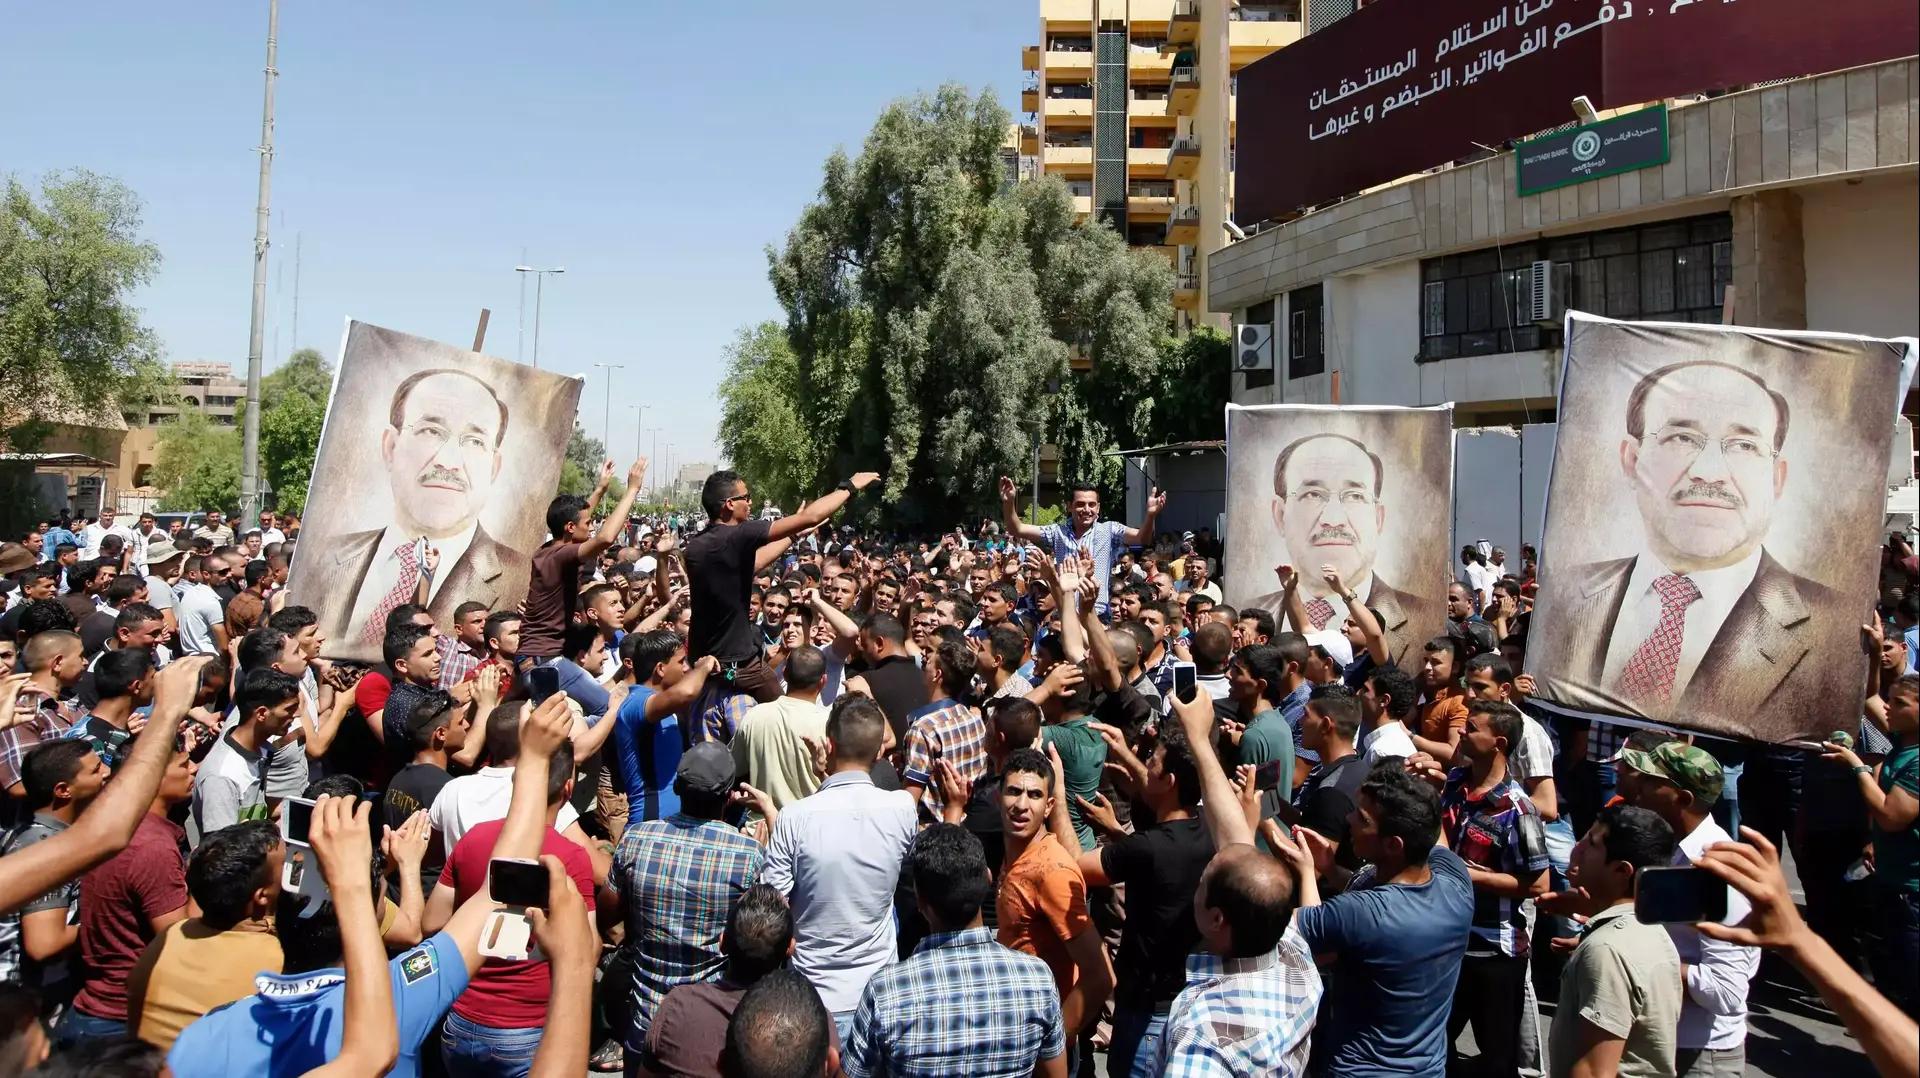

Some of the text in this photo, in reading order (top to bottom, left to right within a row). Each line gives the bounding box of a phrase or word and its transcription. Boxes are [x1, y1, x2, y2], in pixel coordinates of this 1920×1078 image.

[1435, 7, 1507, 62] استلام
[1309, 48, 1417, 111] المستحقات
[1381, 67, 1451, 118] التبضع
[1309, 106, 1360, 140] غيرها
[1364, 104, 1374, 123] و
